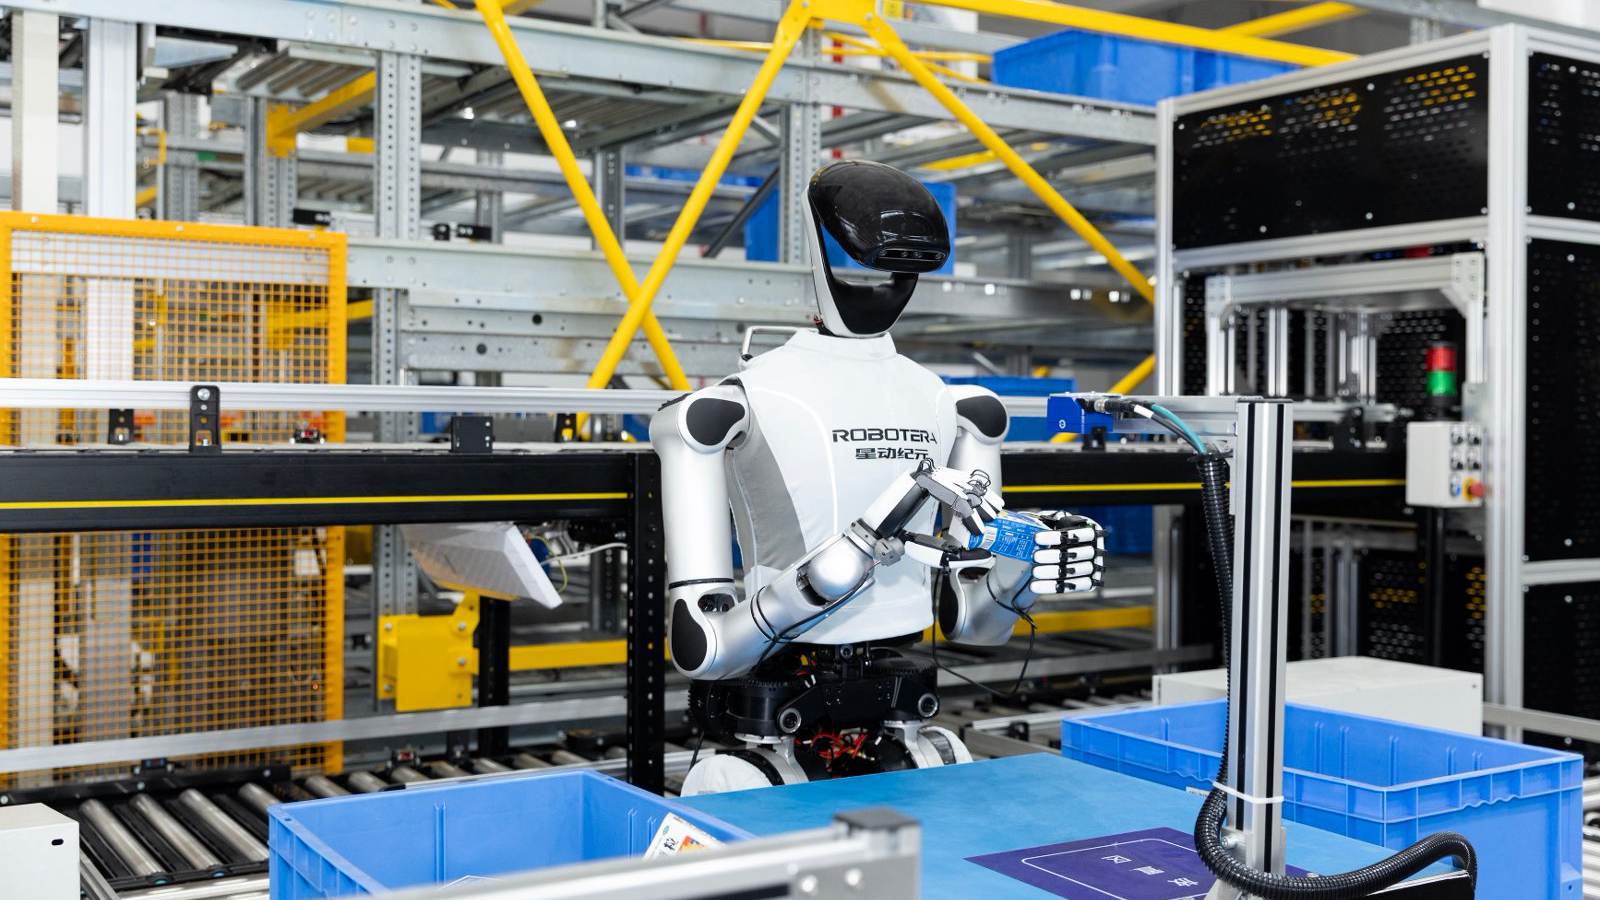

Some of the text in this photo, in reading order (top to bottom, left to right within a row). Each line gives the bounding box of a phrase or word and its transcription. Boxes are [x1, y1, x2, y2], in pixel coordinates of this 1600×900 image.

[832, 428, 937, 444] ROBOTERA
[856, 447, 928, 459] 星动纪元
